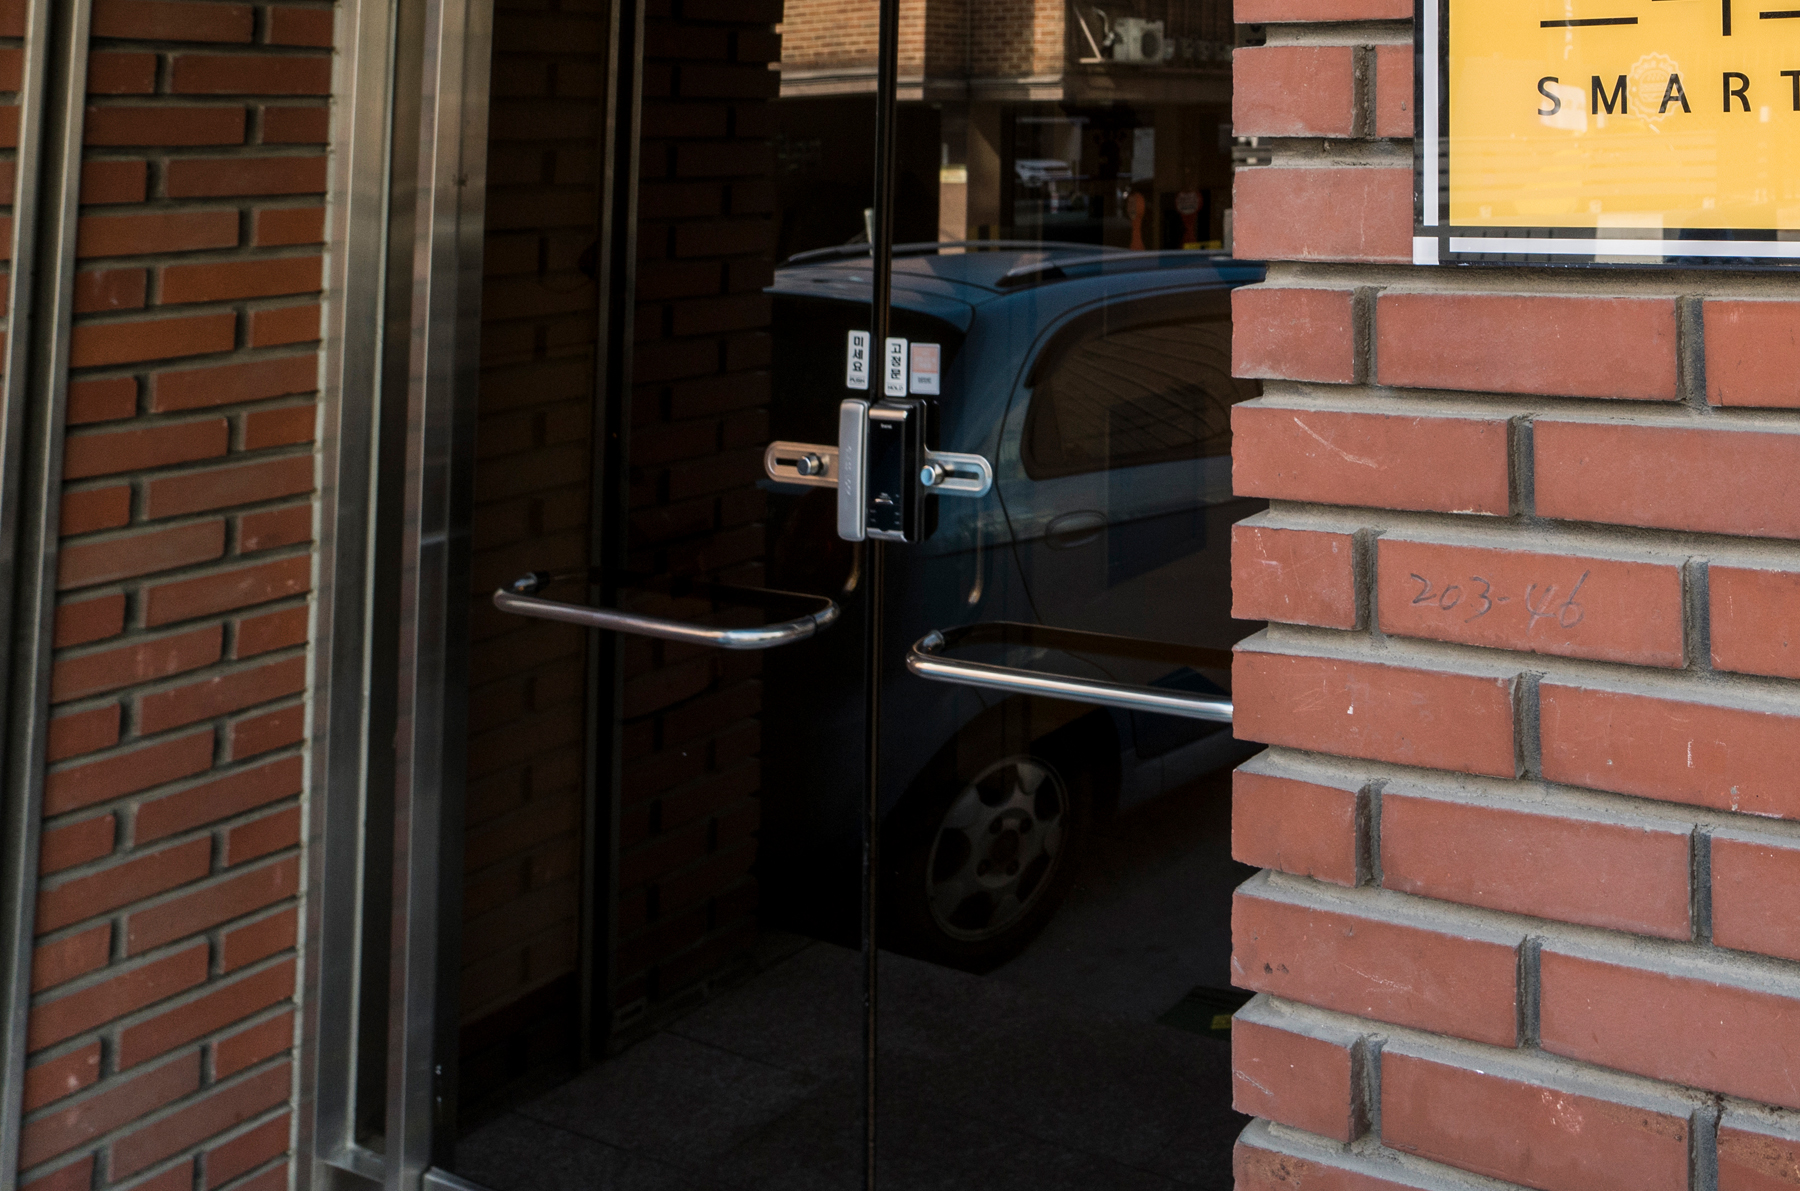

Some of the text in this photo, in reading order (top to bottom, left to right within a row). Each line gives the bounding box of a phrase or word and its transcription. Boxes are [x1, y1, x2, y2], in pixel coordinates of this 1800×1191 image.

[852, 335, 864, 373] 미세요
[890, 342, 902, 381] 고정문
[849, 375, 865, 385] PUSH
[1409, 568, 1592, 636] 203-46
